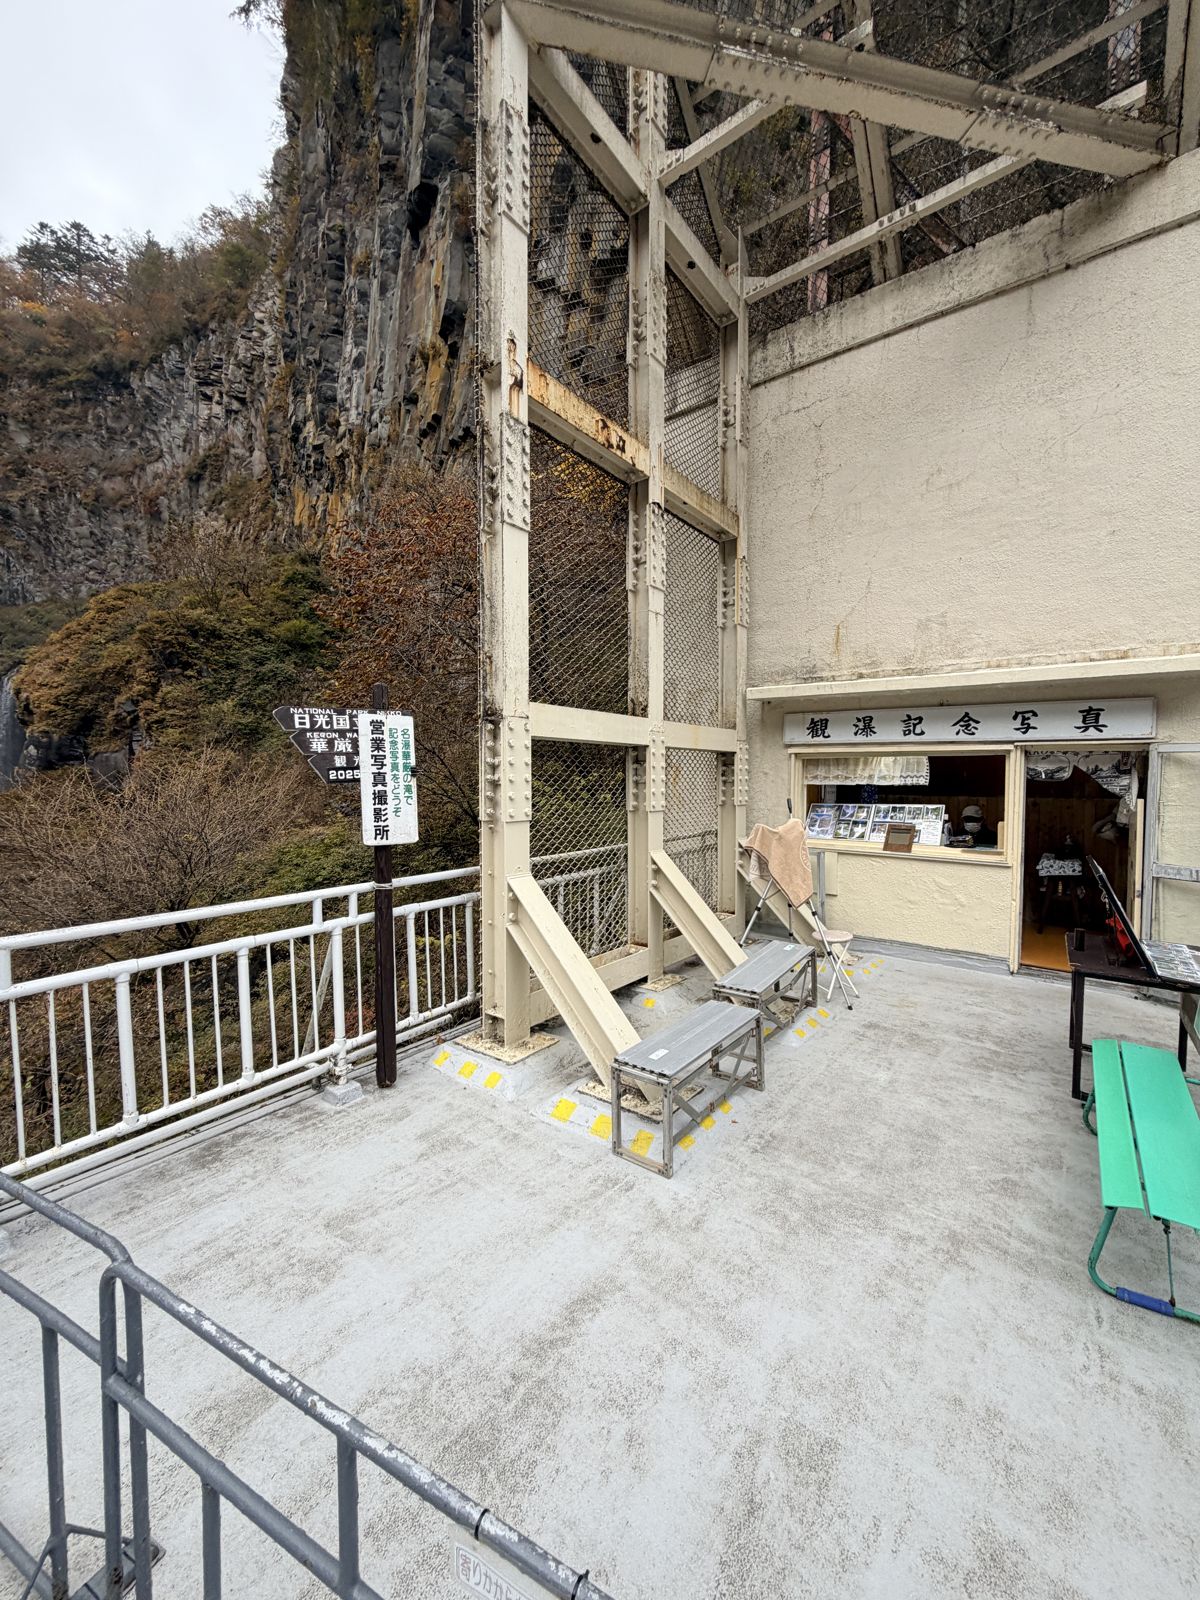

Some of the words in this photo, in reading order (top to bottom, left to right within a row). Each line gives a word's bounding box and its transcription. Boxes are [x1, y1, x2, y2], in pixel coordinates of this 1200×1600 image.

[290, 707, 338, 715] NATIONAL
[806, 706, 1108, 740] 観瀑記念写真
[309, 737, 359, 753] 華厳
[369, 719, 390, 841] 営業写真撮影所
[388, 728, 402, 818] 記念写真をどうぞ
